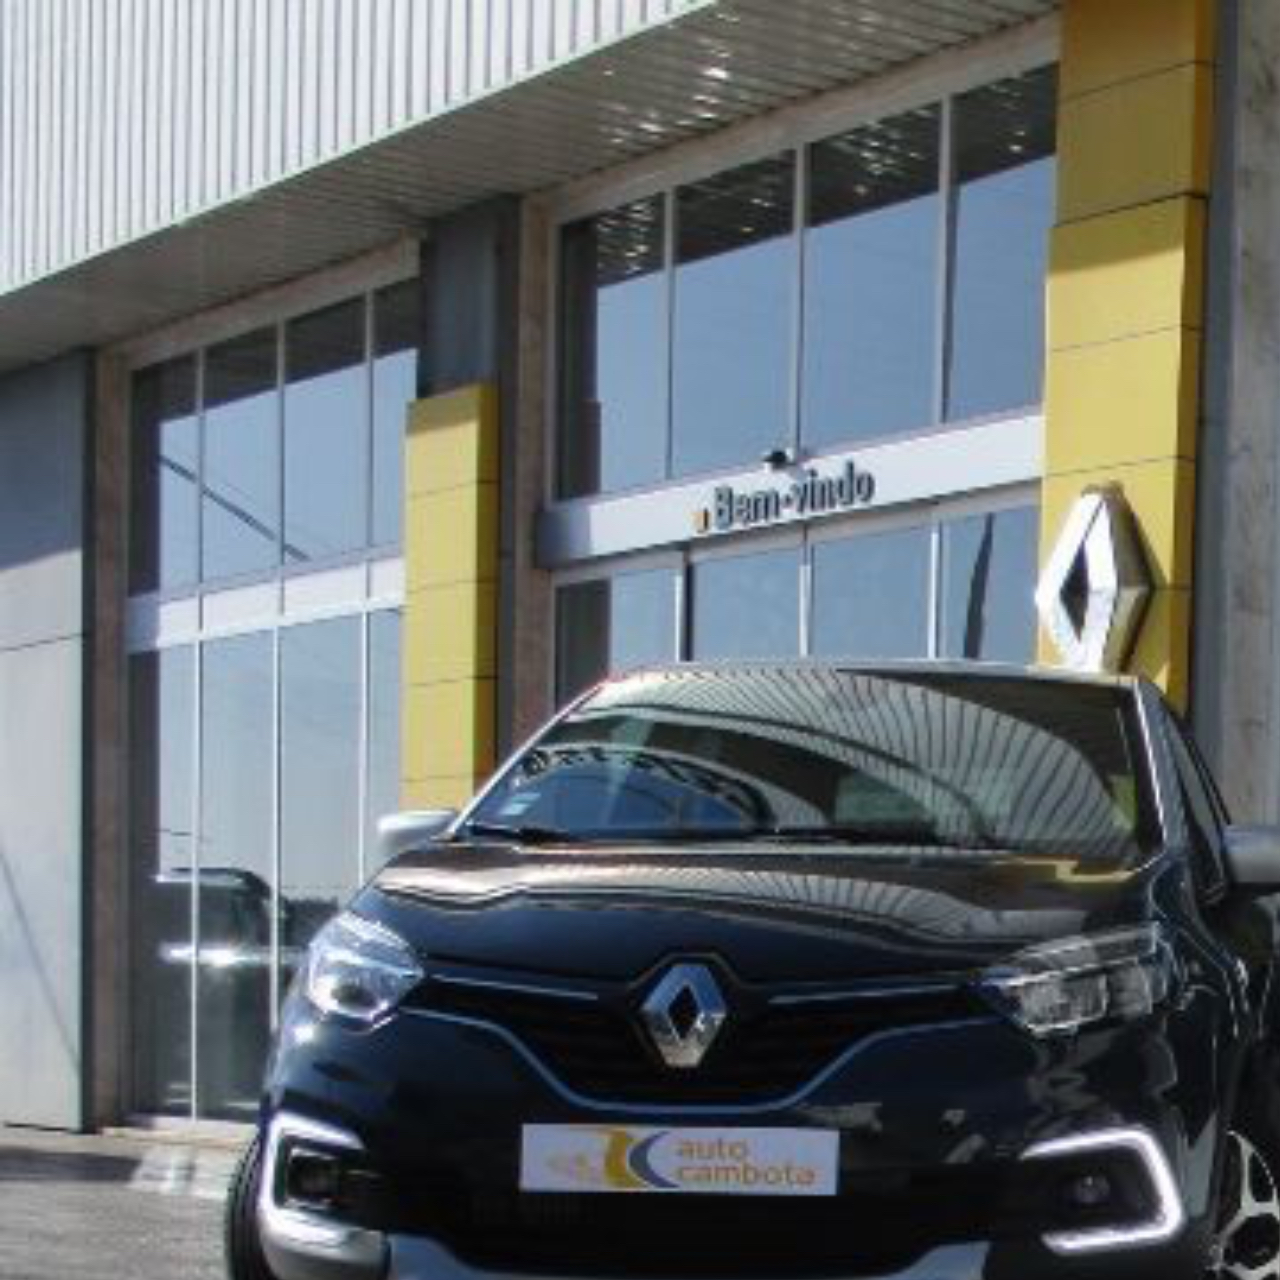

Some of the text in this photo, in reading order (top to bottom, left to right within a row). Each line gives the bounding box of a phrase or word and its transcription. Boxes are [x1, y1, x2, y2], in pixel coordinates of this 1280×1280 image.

[714, 458, 876, 530] Bem-vindo
[678, 1137, 749, 1161] auto
[676, 1162, 816, 1187] cambota
